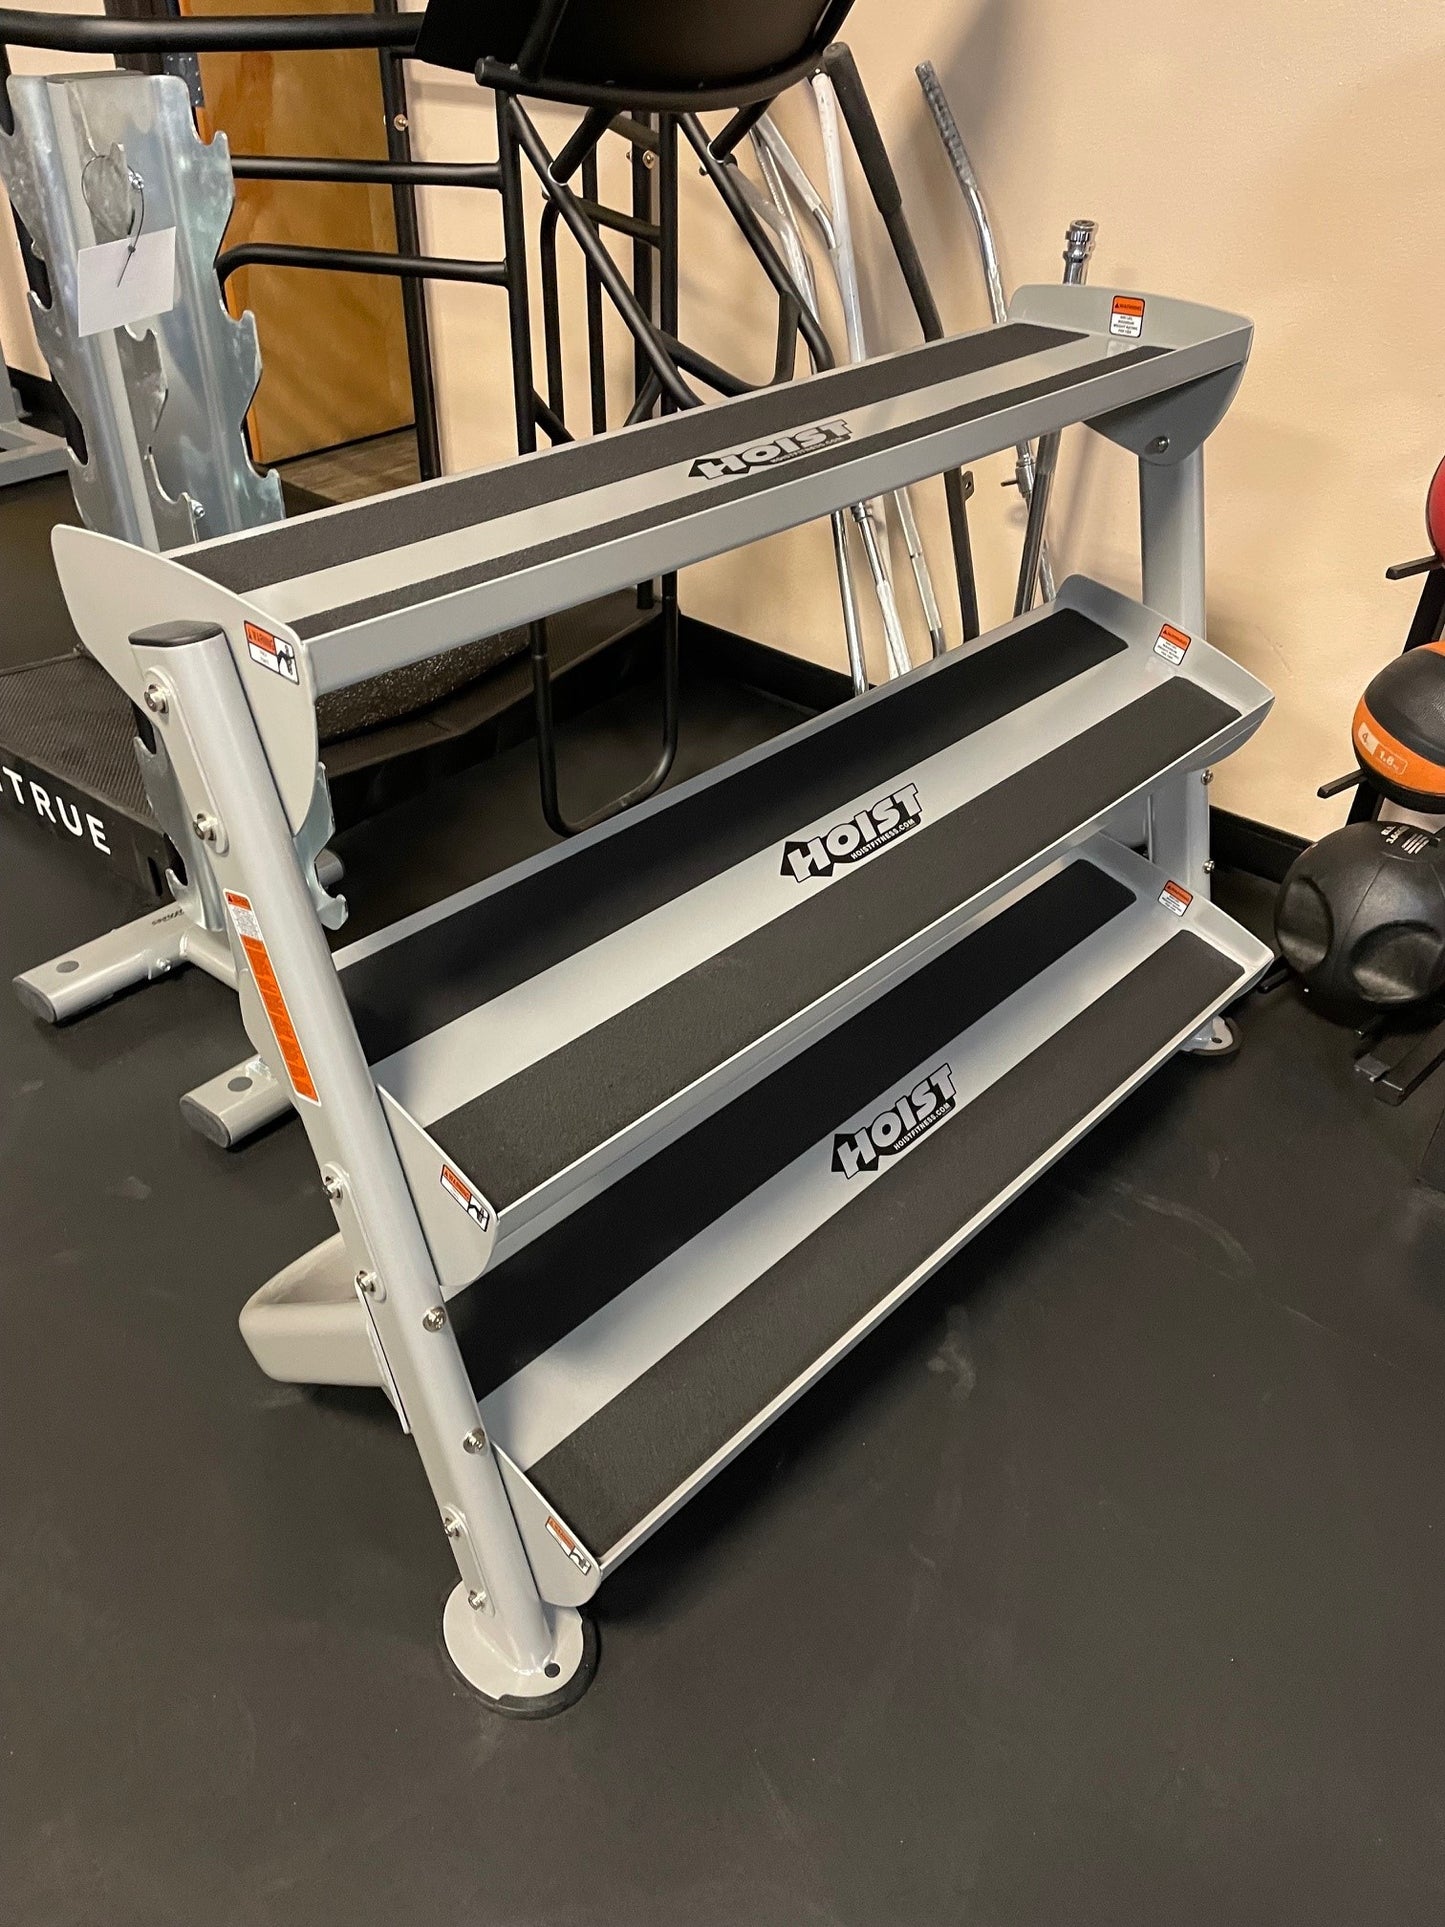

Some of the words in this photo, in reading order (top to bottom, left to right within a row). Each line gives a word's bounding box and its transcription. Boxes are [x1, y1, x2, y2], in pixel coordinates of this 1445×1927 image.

[696, 419, 852, 480] HOIST
[2, 765, 112, 856] TRUE
[786, 782, 922, 884] HOIST
[850, 818, 916, 861] HOISTFITNESS.COM
[836, 1062, 957, 1181] HOIST
[893, 1102, 951, 1151] HOISTFITNESS.COM
